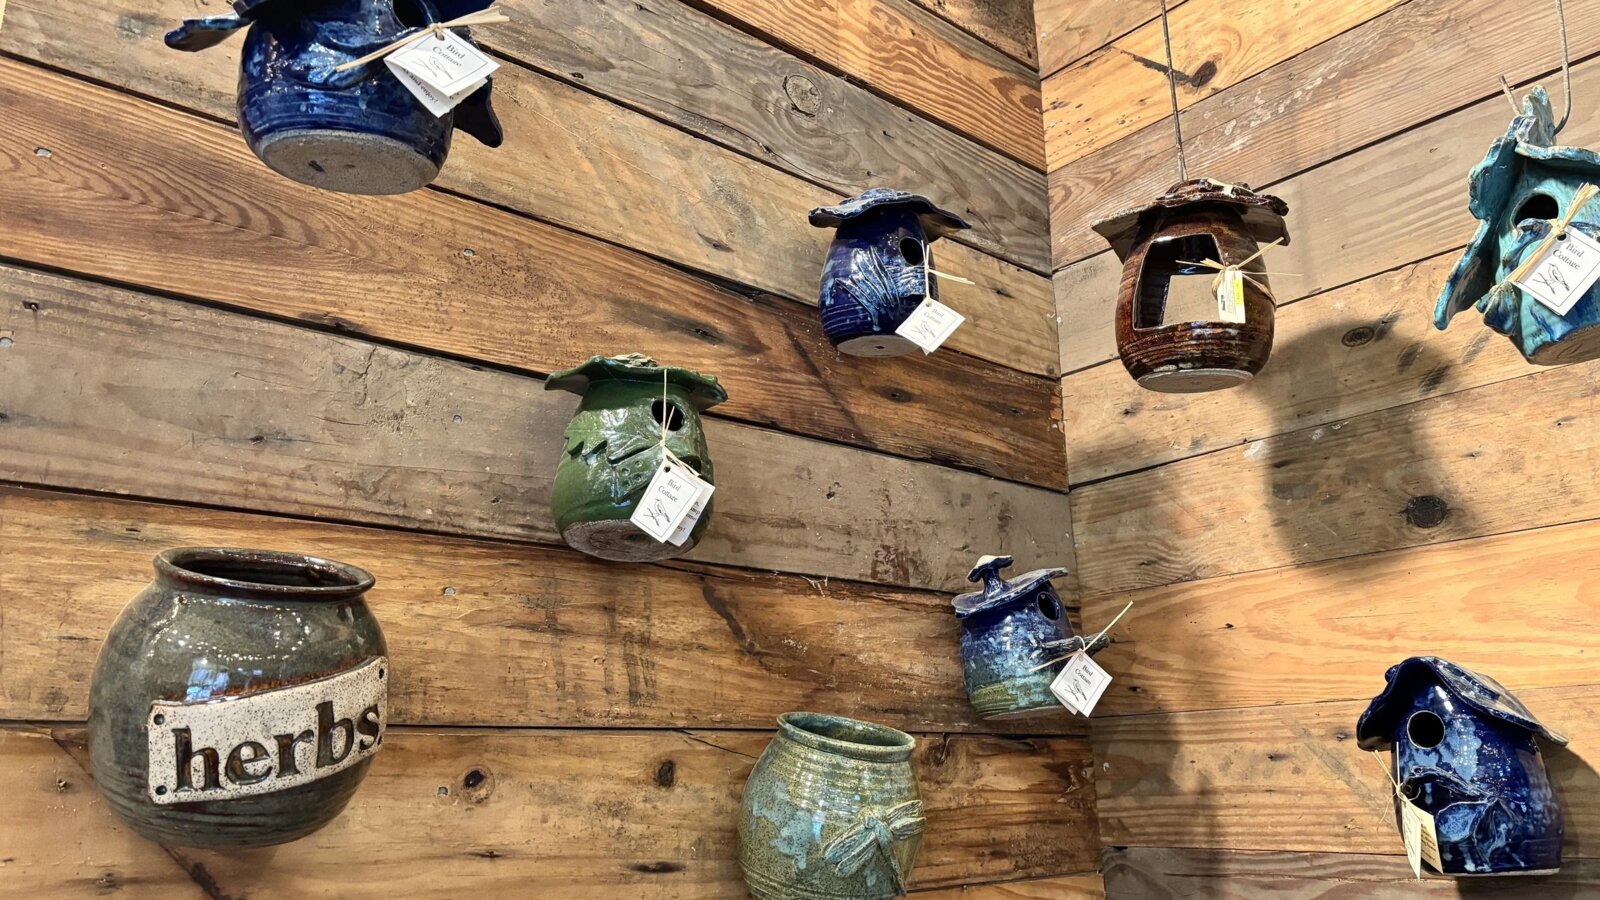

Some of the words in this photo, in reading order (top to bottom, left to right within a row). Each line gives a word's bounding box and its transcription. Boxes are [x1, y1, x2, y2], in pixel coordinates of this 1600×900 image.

[432, 46, 462, 67] Cottage
[446, 44, 466, 59] Bird
[1565, 243, 1585, 258] Bird
[1553, 249, 1581, 270] Cottage
[667, 479, 682, 492] Bird
[658, 485, 679, 503] Cottage
[1082, 664, 1094, 677] Bird
[172, 701, 381, 792] herbs
